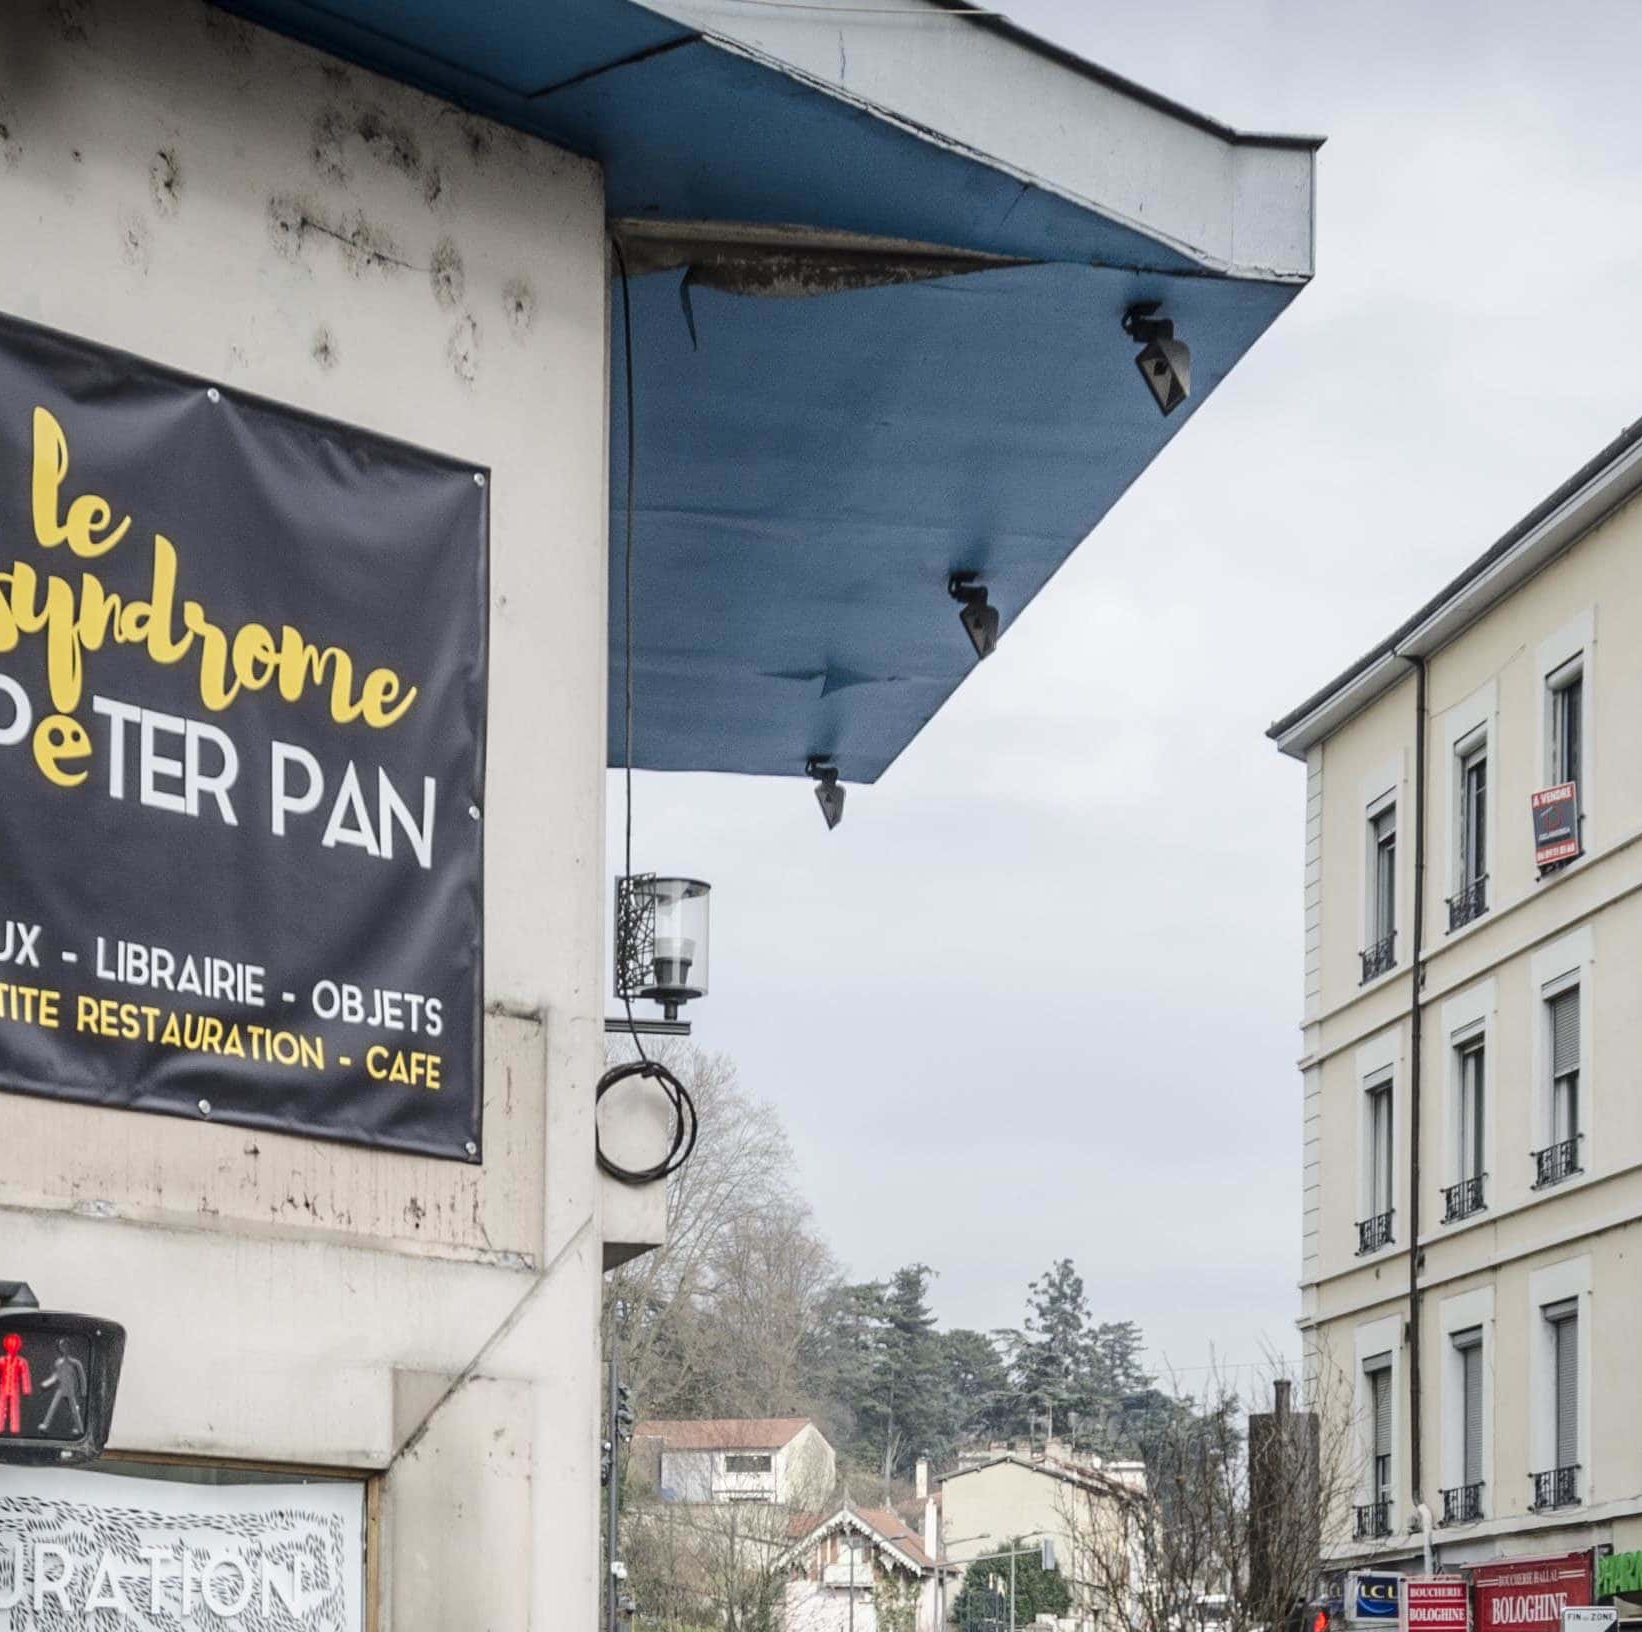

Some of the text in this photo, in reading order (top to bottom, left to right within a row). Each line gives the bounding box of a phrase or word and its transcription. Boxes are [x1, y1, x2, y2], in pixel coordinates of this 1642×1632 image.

[32, 407, 130, 557] le
[271, 742, 436, 869] PAN
[96, 937, 266, 1008] LIBRAIRIE
[311, 980, 444, 1038] OBJETS
[78, 994, 325, 1071] RESTAURATION
[366, 1047, 443, 1091] CAFE
[1360, 1583, 1398, 1599] LCL
[1409, 1608, 1465, 1623] BOLOGHINE
[1410, 1587, 1464, 1598] BOUCHERIE
[1567, 1613, 1581, 1622] FIN
[1590, 1612, 1614, 1622] ZONE
